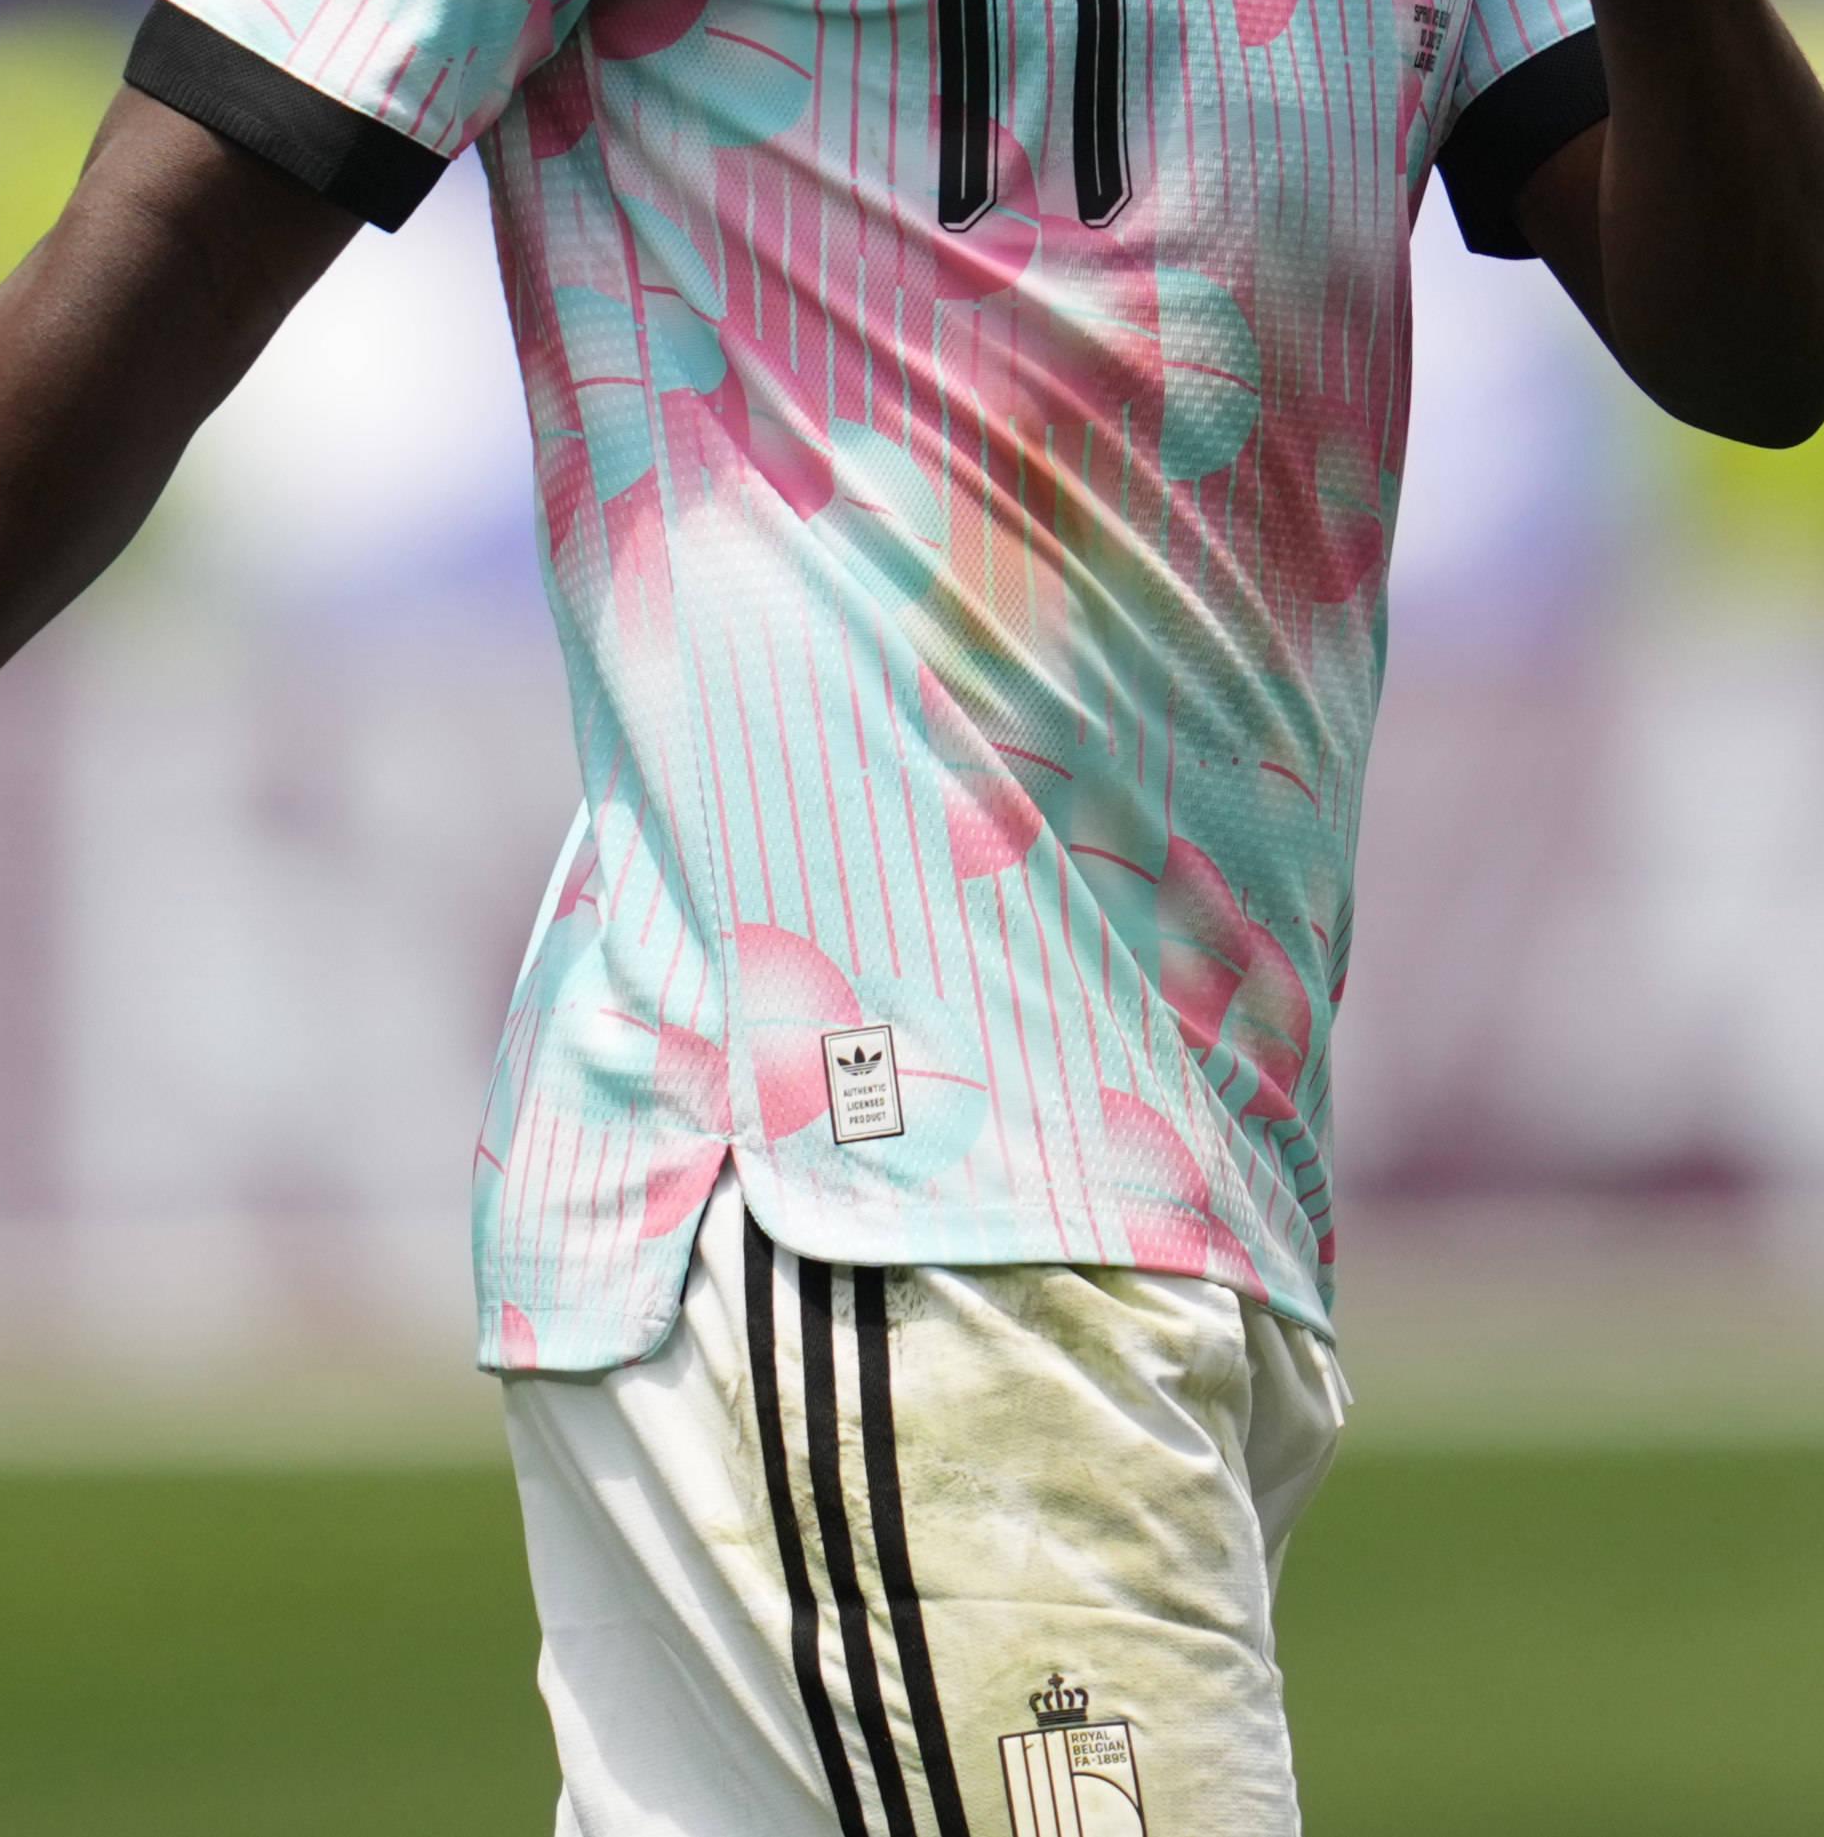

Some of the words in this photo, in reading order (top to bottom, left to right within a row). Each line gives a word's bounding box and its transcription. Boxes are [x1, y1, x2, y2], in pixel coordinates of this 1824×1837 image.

[843, 1083, 887, 1097] AUTHENTIC
[847, 1097, 885, 1111] LICENSED
[1071, 1731, 1110, 1743] ROYAL
[1072, 1741, 1125, 1755] BELGIAN
